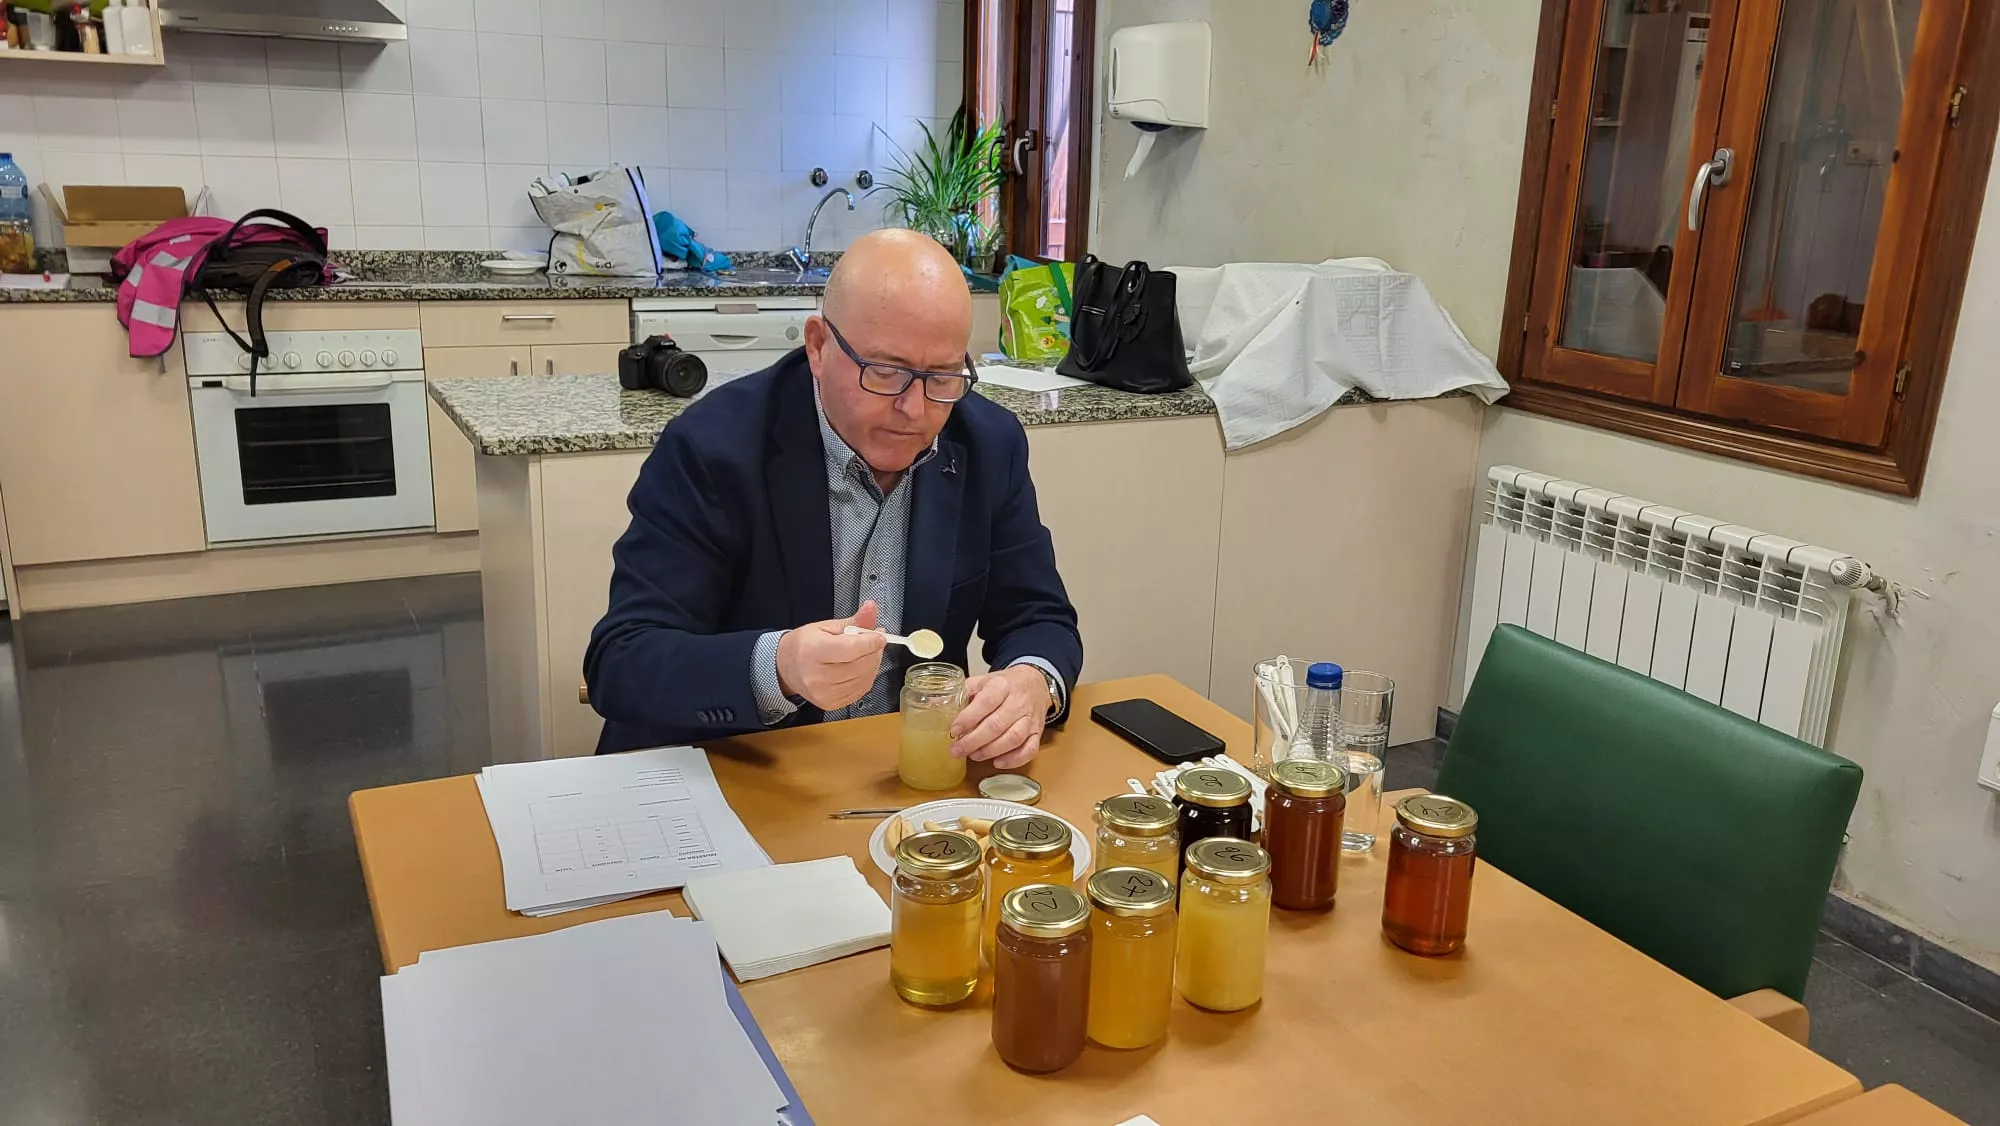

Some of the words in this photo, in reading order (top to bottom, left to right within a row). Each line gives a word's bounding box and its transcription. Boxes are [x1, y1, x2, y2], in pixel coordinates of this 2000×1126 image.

[1024, 821, 1049, 841] 22
[919, 840, 956, 859] 23
[1122, 875, 1153, 898] 27
